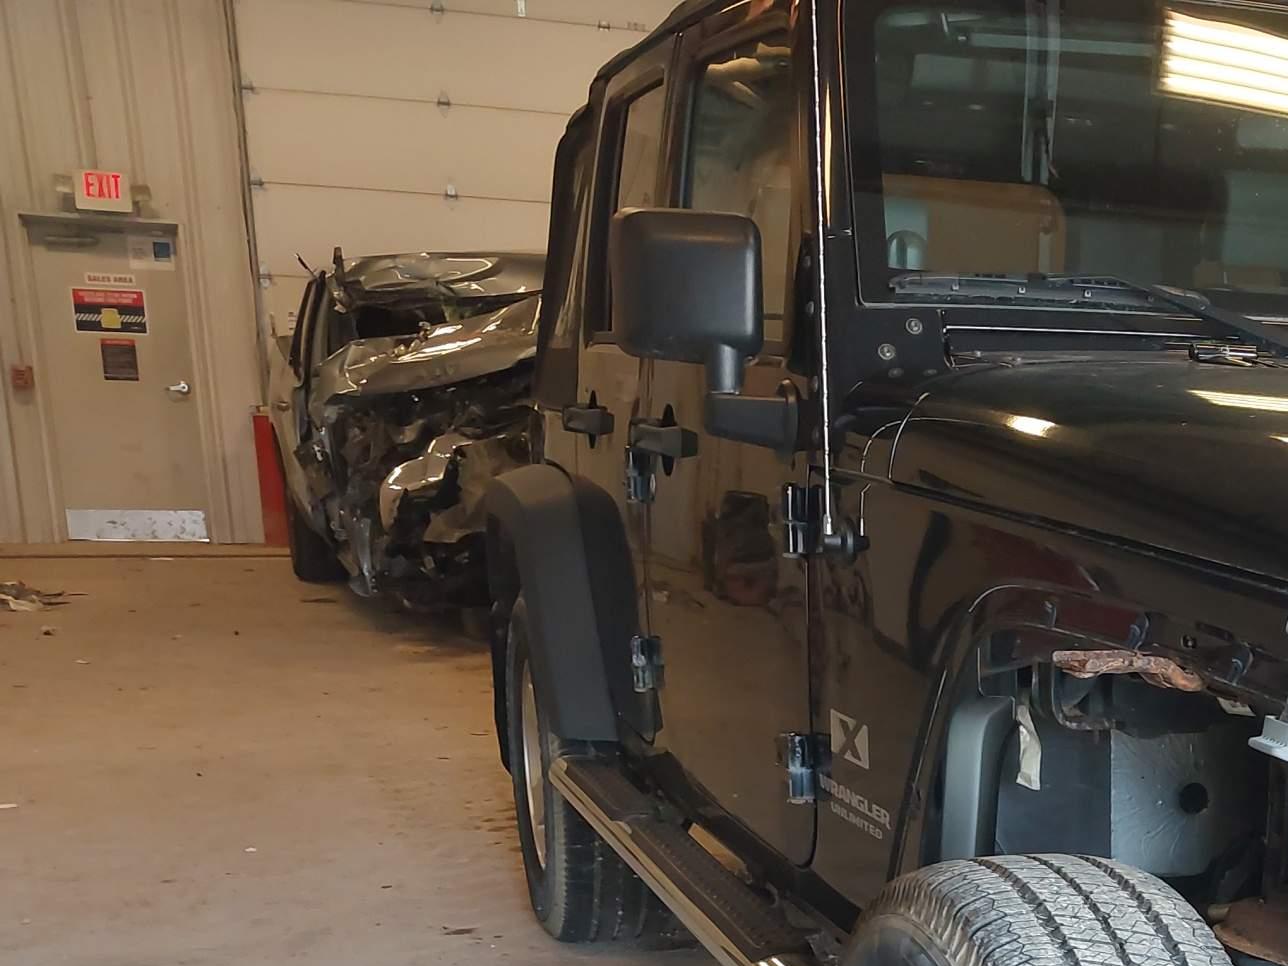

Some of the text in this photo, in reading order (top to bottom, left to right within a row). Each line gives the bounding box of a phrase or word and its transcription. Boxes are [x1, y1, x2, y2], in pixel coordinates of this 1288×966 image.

[84, 172, 121, 199] EXIT
[819, 773, 892, 831] WRANGLER
[830, 800, 883, 840] UNLIMITED
